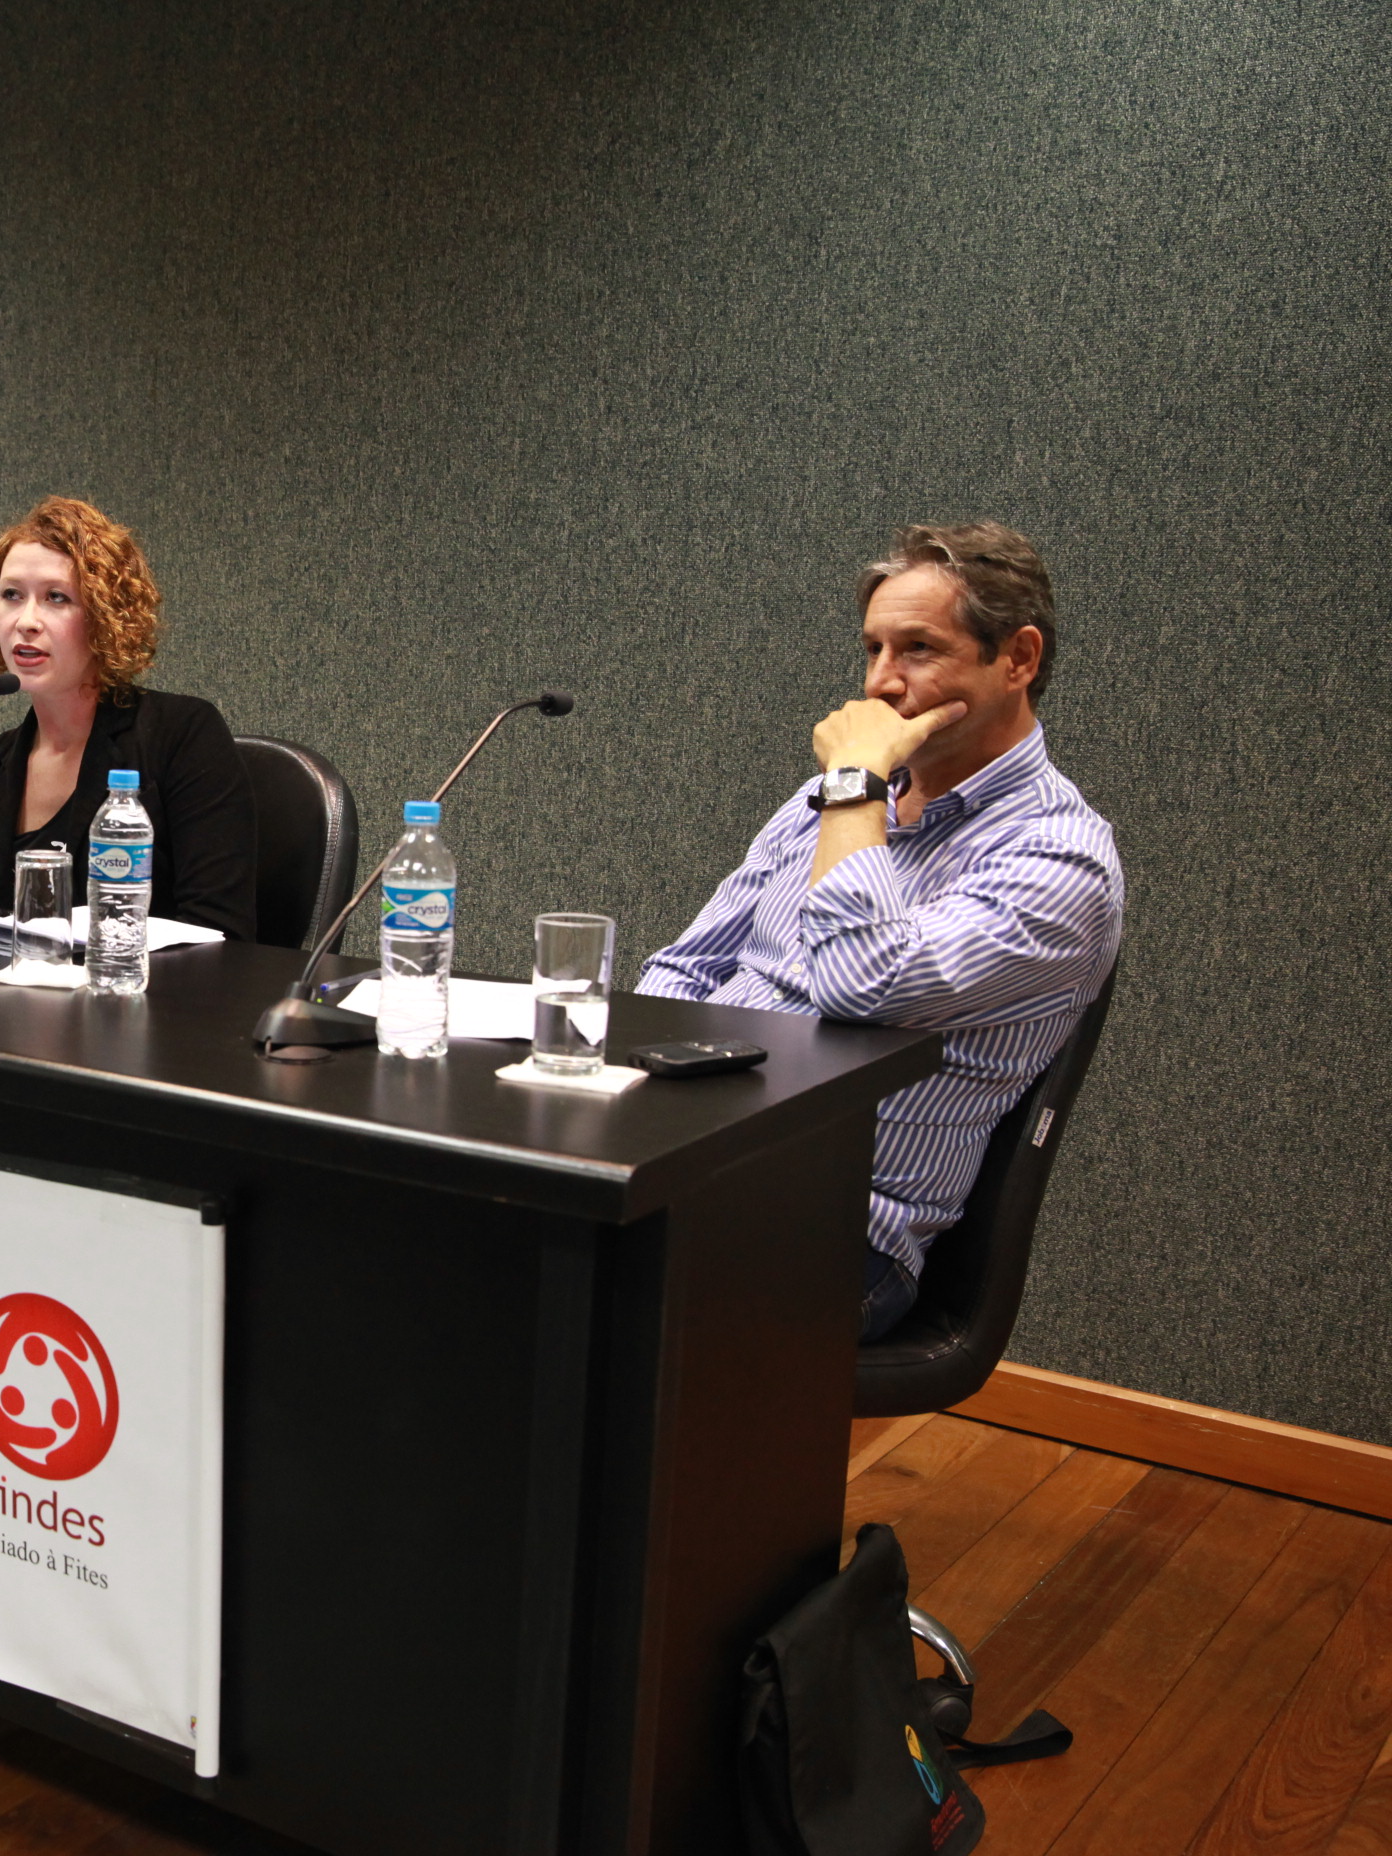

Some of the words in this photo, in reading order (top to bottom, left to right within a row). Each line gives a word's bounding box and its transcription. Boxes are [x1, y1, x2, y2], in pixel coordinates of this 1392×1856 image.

[95, 857, 129, 868] crystal
[46, 1549, 57, 1571] à
[63, 1554, 109, 1590] Fites
